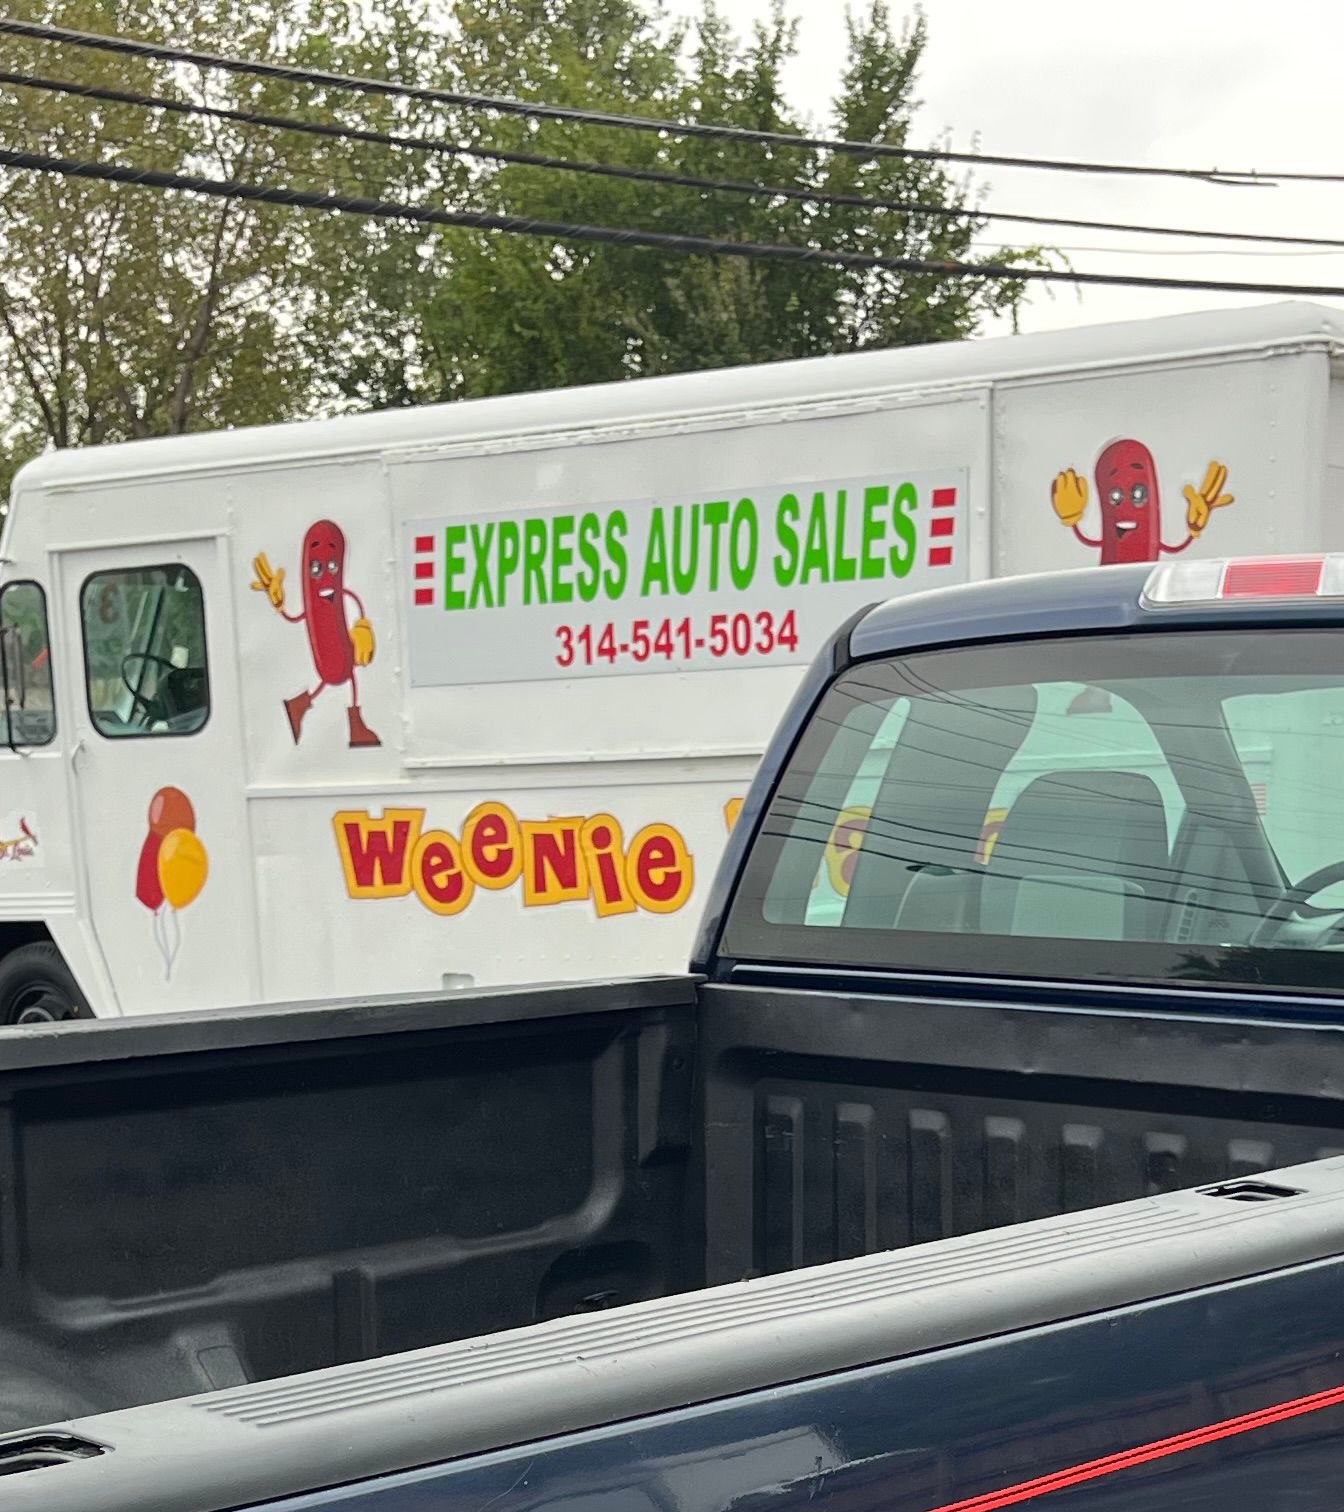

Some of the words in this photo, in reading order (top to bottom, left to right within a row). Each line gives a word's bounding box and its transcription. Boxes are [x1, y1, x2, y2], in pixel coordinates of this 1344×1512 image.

[444, 510, 628, 611] EXPRESS
[641, 498, 758, 598] AUTO
[773, 482, 919, 588] SALES
[556, 609, 799, 668] 314-541-5034
